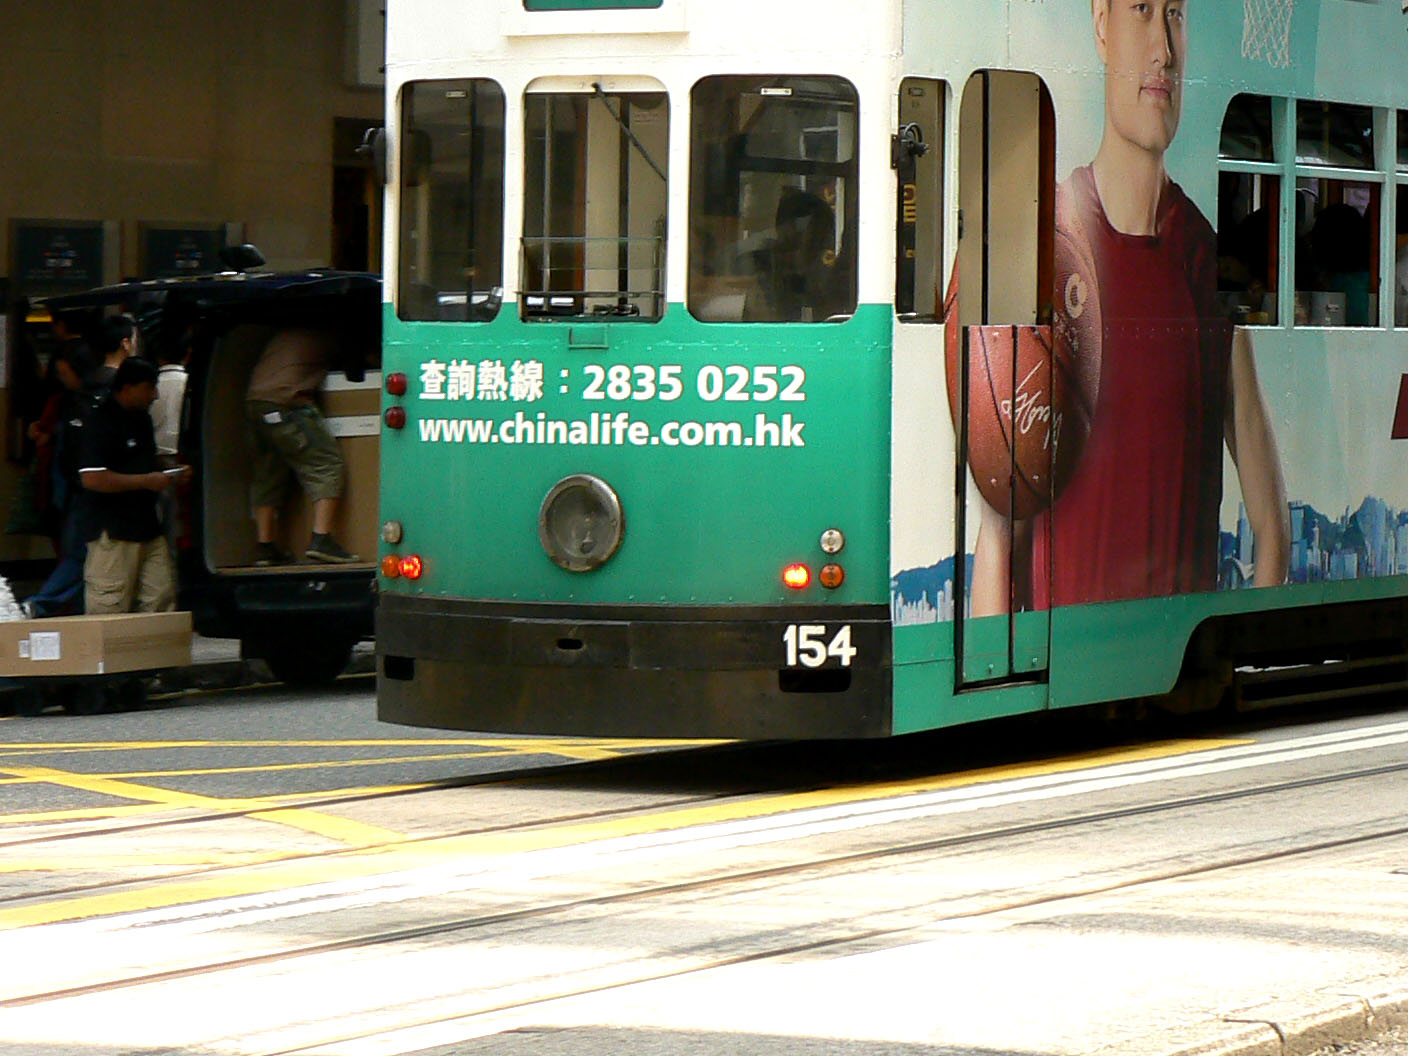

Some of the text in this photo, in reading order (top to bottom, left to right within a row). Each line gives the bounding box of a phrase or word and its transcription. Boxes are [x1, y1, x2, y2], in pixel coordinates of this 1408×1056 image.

[582, 364, 684, 402] 2835
[697, 364, 806, 402] 0252
[418, 411, 806, 447] www.chinalife.com.hk
[783, 624, 857, 667] 154
